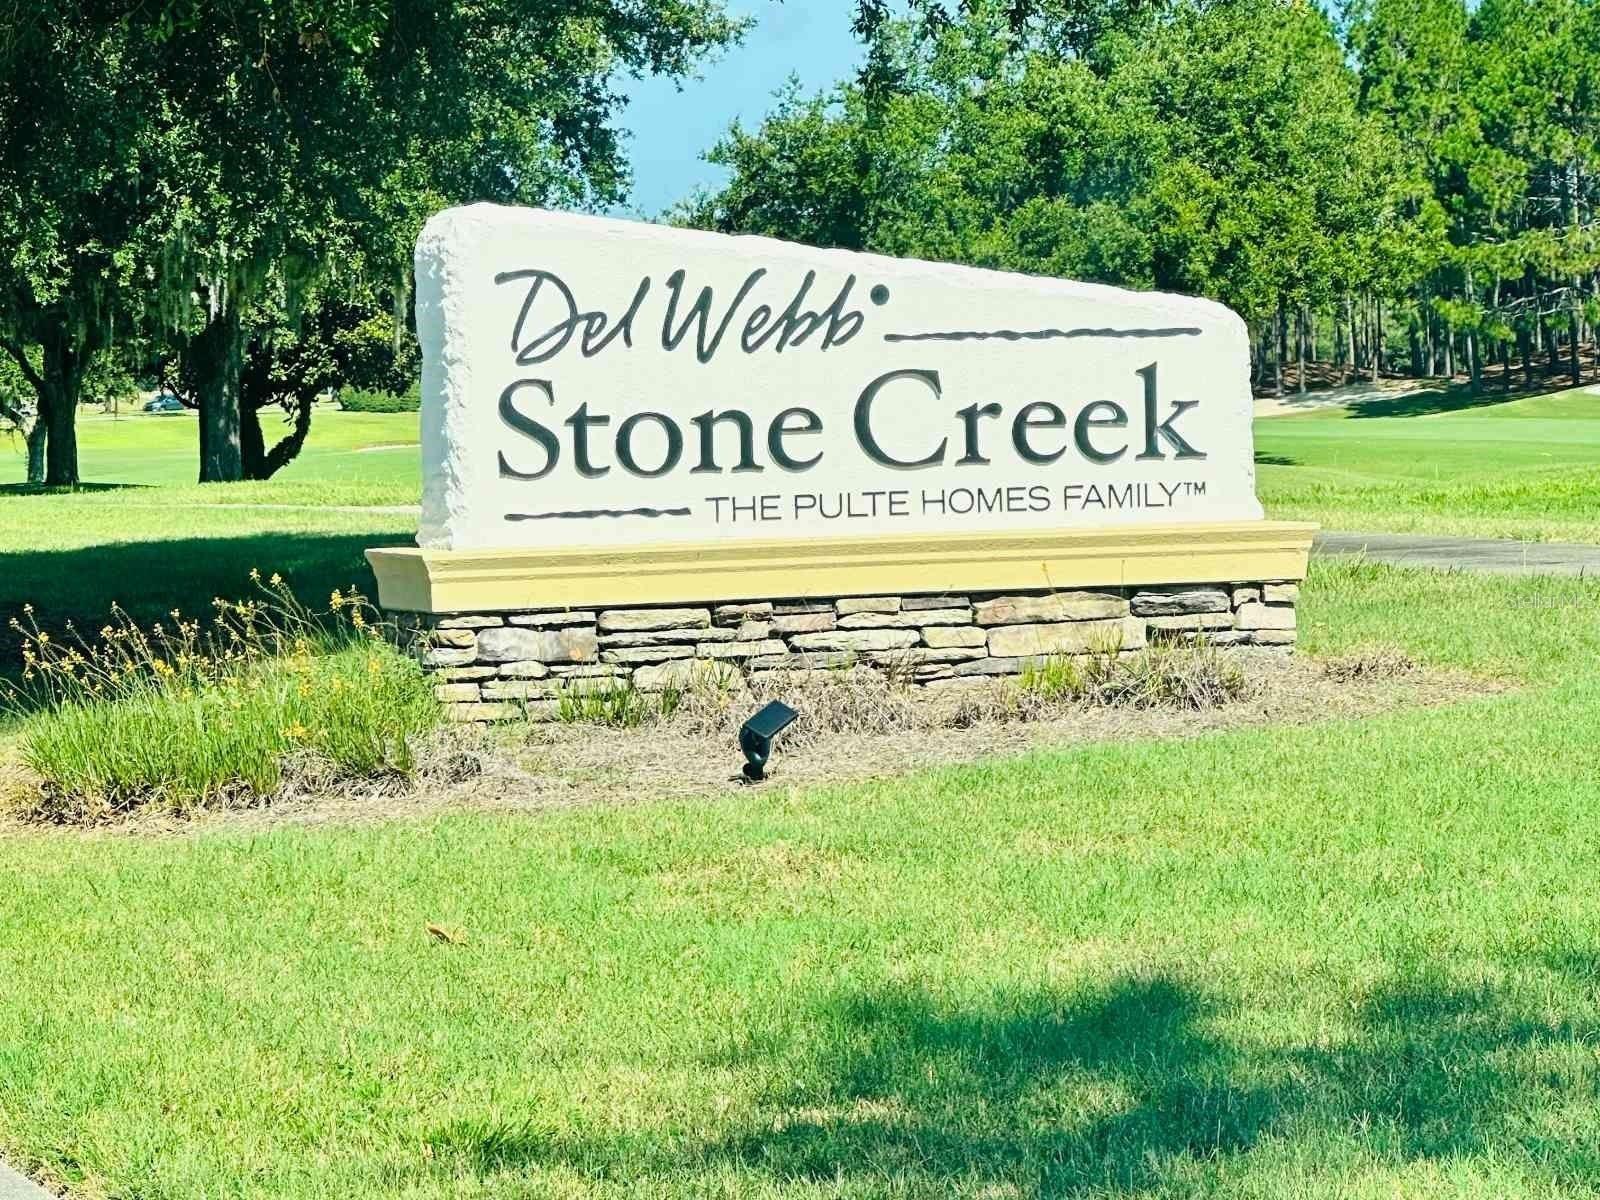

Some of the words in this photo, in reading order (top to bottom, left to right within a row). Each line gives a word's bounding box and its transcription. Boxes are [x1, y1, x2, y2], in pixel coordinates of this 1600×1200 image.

[494, 269, 651, 366] Del
[661, 267, 865, 364] Webb
[497, 378, 824, 481] Stone
[853, 361, 1208, 471] Creek
[705, 494, 782, 523] THE
[794, 489, 910, 520] PULTE
[921, 485, 1051, 515] HOMES
